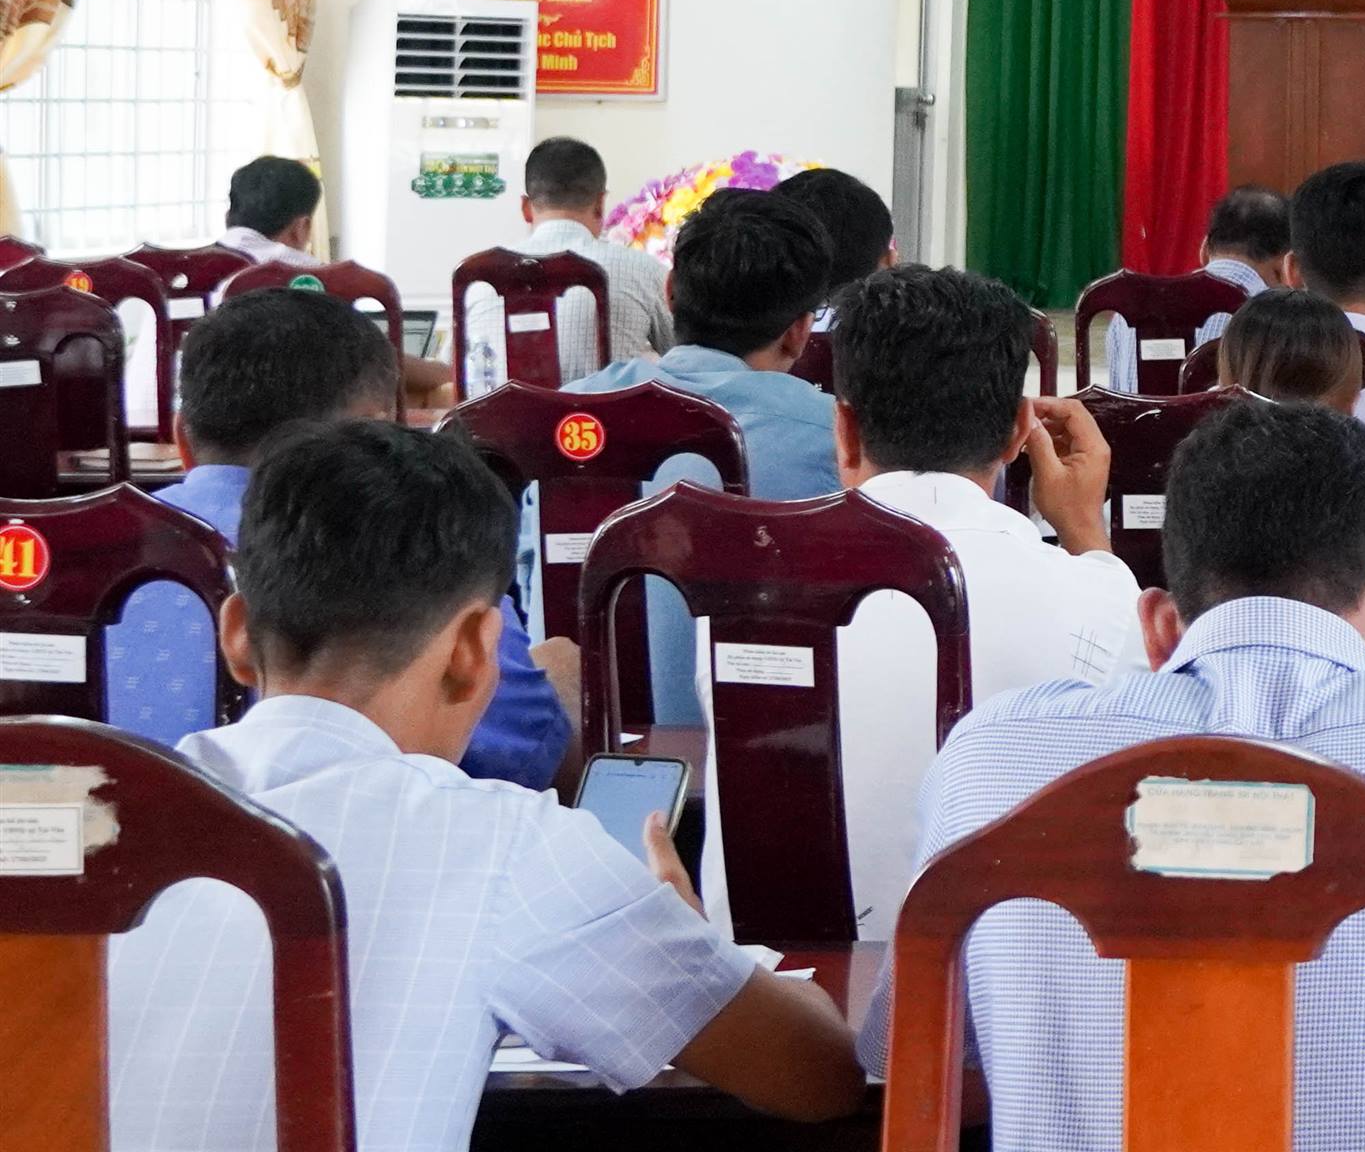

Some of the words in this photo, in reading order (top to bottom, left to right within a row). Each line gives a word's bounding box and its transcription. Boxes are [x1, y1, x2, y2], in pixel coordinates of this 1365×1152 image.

[542, 55, 577, 70] Minh
[563, 422, 597, 451] 35
[0, 536, 35, 578] 41
